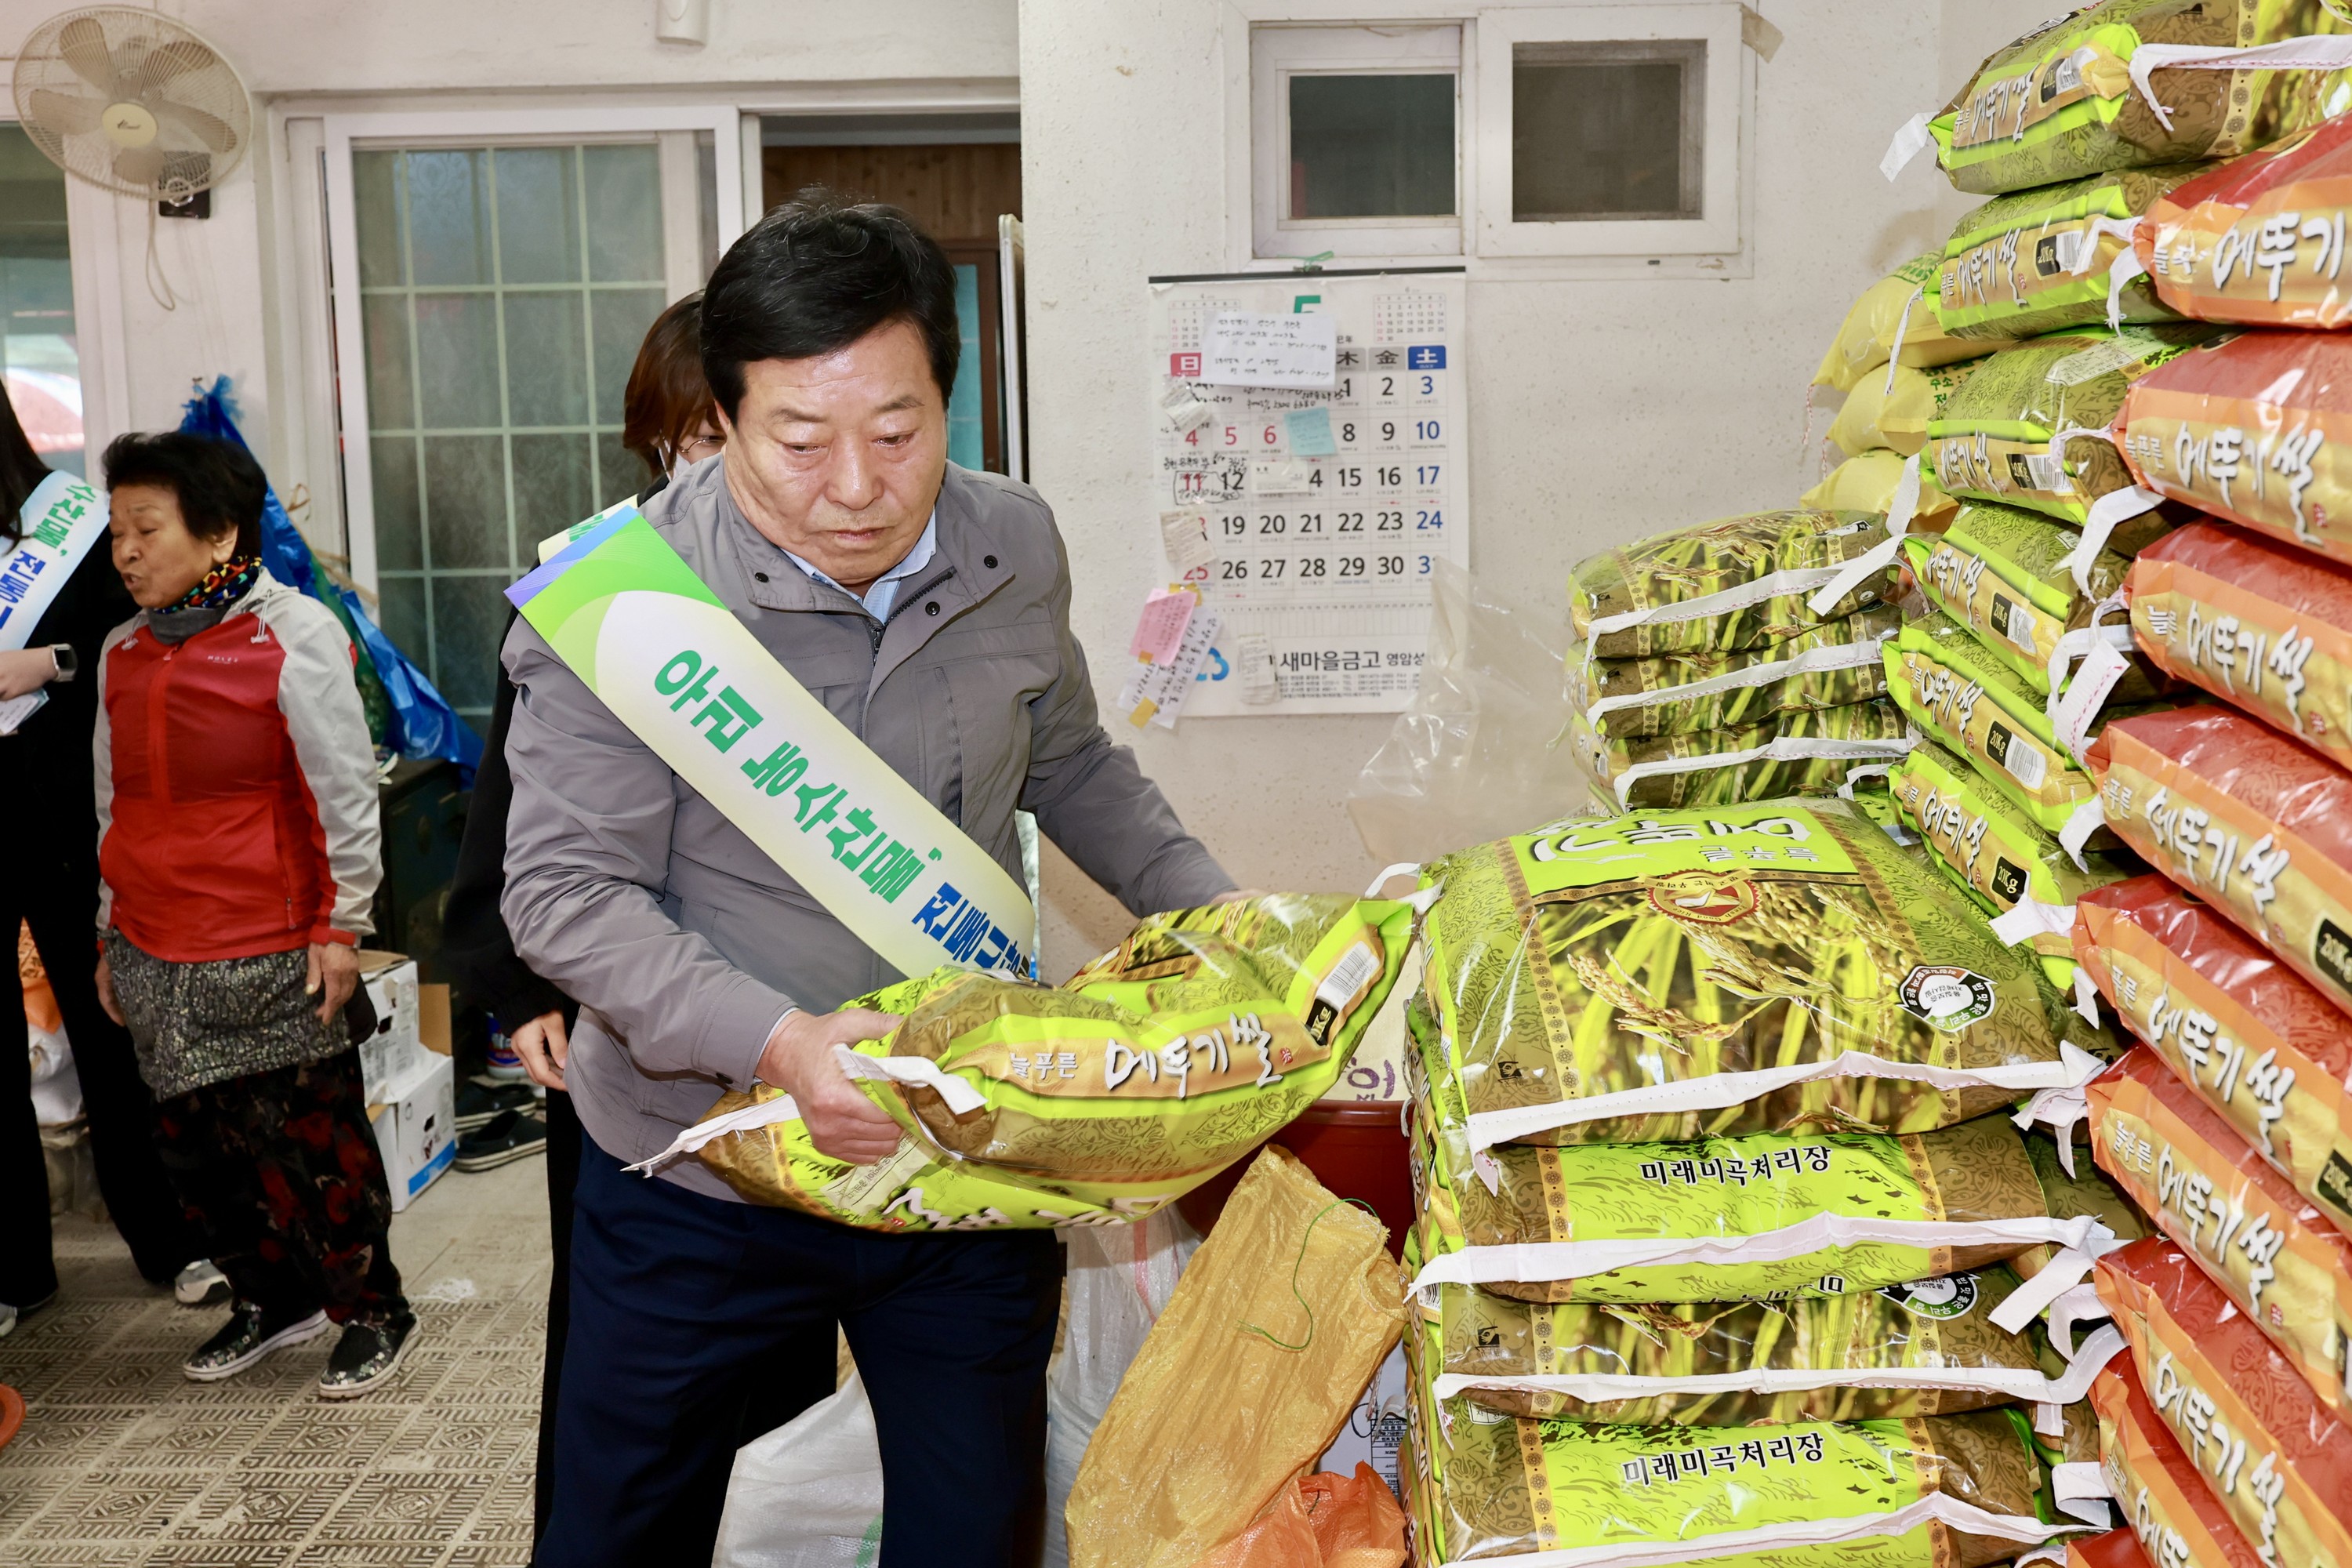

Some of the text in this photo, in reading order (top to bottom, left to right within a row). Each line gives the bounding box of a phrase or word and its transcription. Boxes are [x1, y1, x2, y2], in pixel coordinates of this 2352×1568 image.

[1180, 356, 1199, 371] 日
[1337, 351, 1359, 365] 木
[1375, 350, 1399, 365] 金
[1416, 349, 1438, 364] 土
[1382, 377, 1393, 396] 2
[1421, 376, 1433, 395] 3
[1931, 376, 1954, 390] 주소
[1225, 427, 1237, 445] 5
[1264, 426, 1276, 445] 6
[1343, 423, 1356, 441] 8
[1382, 423, 1395, 441] 9
[1416, 421, 1440, 440] 10
[1221, 471, 1244, 490] 12
[1309, 469, 1323, 488] 4
[1338, 468, 1362, 487] 15
[1377, 467, 1401, 486] 16
[1417, 466, 1440, 485] 17
[1222, 510, 1443, 535] 19 20 21 22 23 24
[1222, 561, 1247, 579] 26
[1261, 560, 1286, 579] 27
[1300, 558, 1326, 577] 28
[1339, 557, 1365, 576] 29
[1377, 556, 1403, 575] 30
[1418, 555, 1436, 574] 3
[1993, 601, 2008, 627] 20Kg
[1279, 651, 1381, 671] 새마을금고
[1990, 725, 2006, 757] 20Kg
[654, 649, 764, 754] 우리
[740, 741, 942, 903] 농수산물,
[1700, 845, 1820, 863] 늘푸른
[1672, 907, 1692, 916] Rice
[1949, 1012, 1970, 1027] 우리
[1010, 1052, 1079, 1079] 늘푸른
[1929, 1305, 1951, 1316] 우리
[1622, 1432, 1824, 1486] 미래미곡처리장
